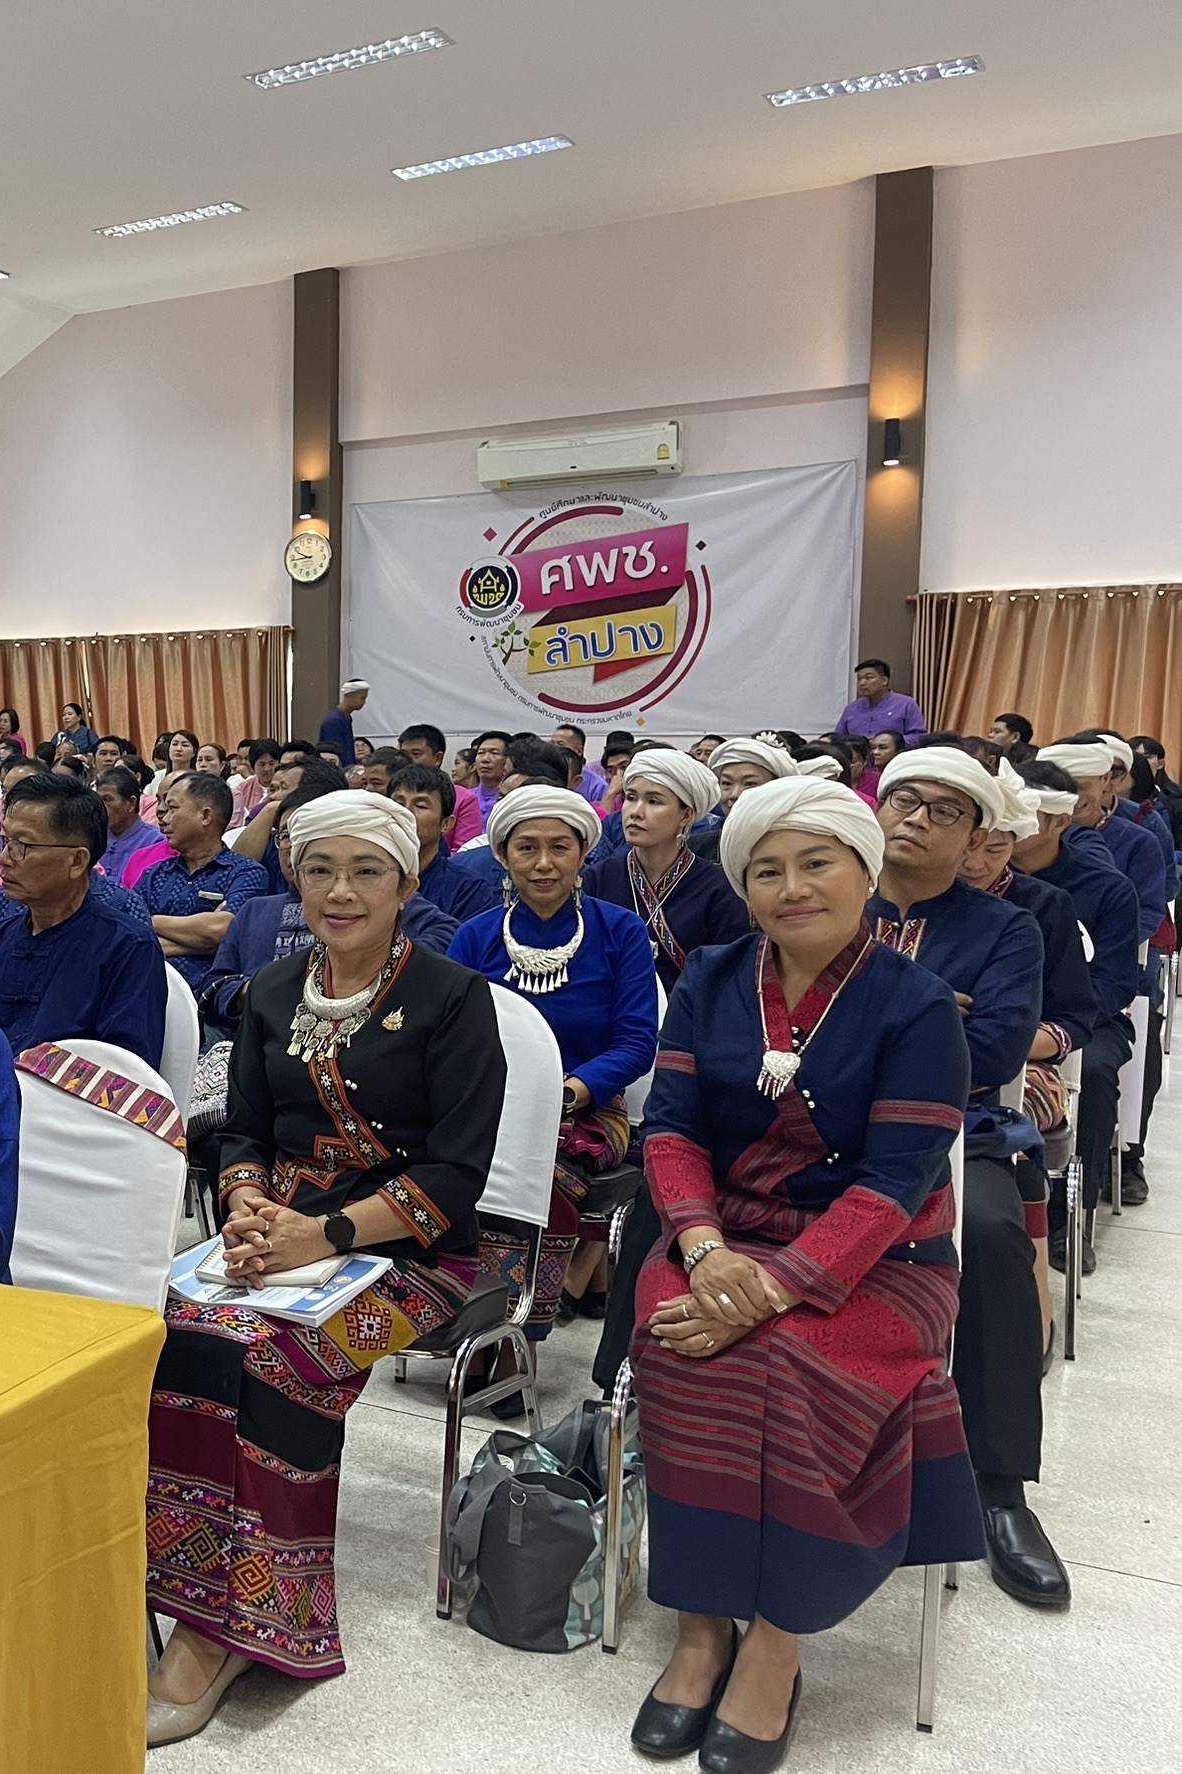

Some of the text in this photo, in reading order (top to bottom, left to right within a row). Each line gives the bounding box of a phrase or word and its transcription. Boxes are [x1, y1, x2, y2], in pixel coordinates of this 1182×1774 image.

[540, 541, 668, 595] ศพช.
[456, 602, 522, 627] กรมการพัฒนาชุมชน
[546, 621, 664, 666] ลำปาง
